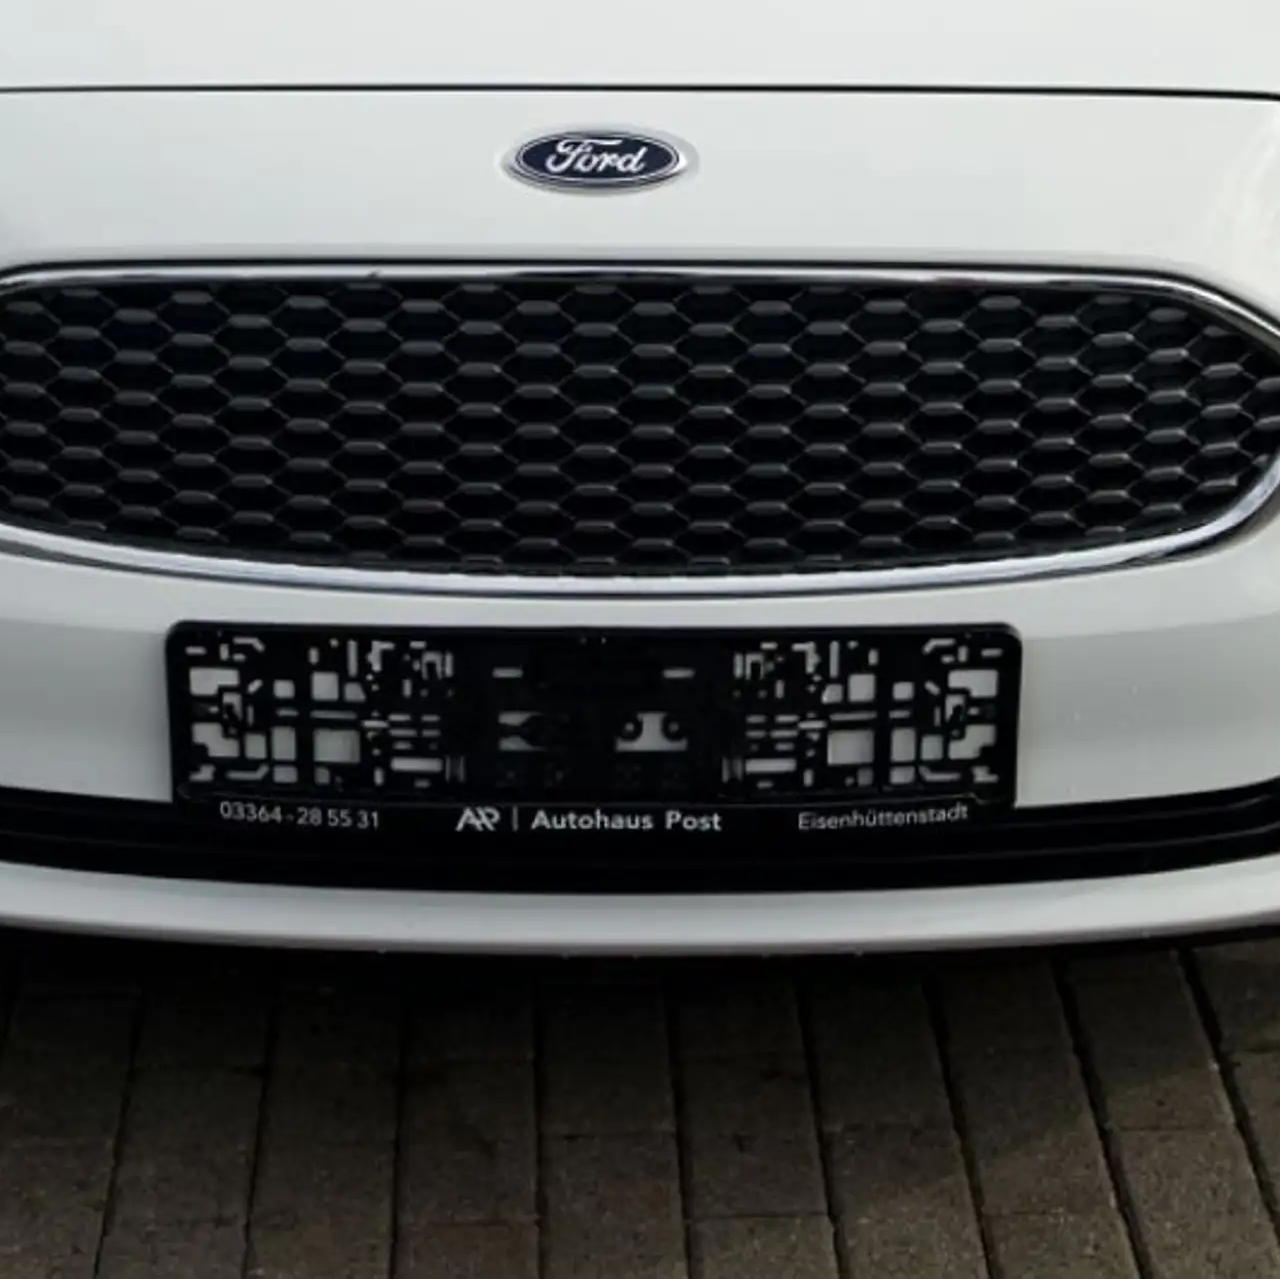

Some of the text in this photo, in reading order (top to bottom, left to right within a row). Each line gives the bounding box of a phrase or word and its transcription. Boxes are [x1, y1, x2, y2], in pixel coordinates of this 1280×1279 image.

[545, 139, 648, 172] Ford
[531, 807, 654, 830] Autohaus
[665, 808, 721, 832] Post
[798, 801, 968, 830] Eisenhüttenstadt
